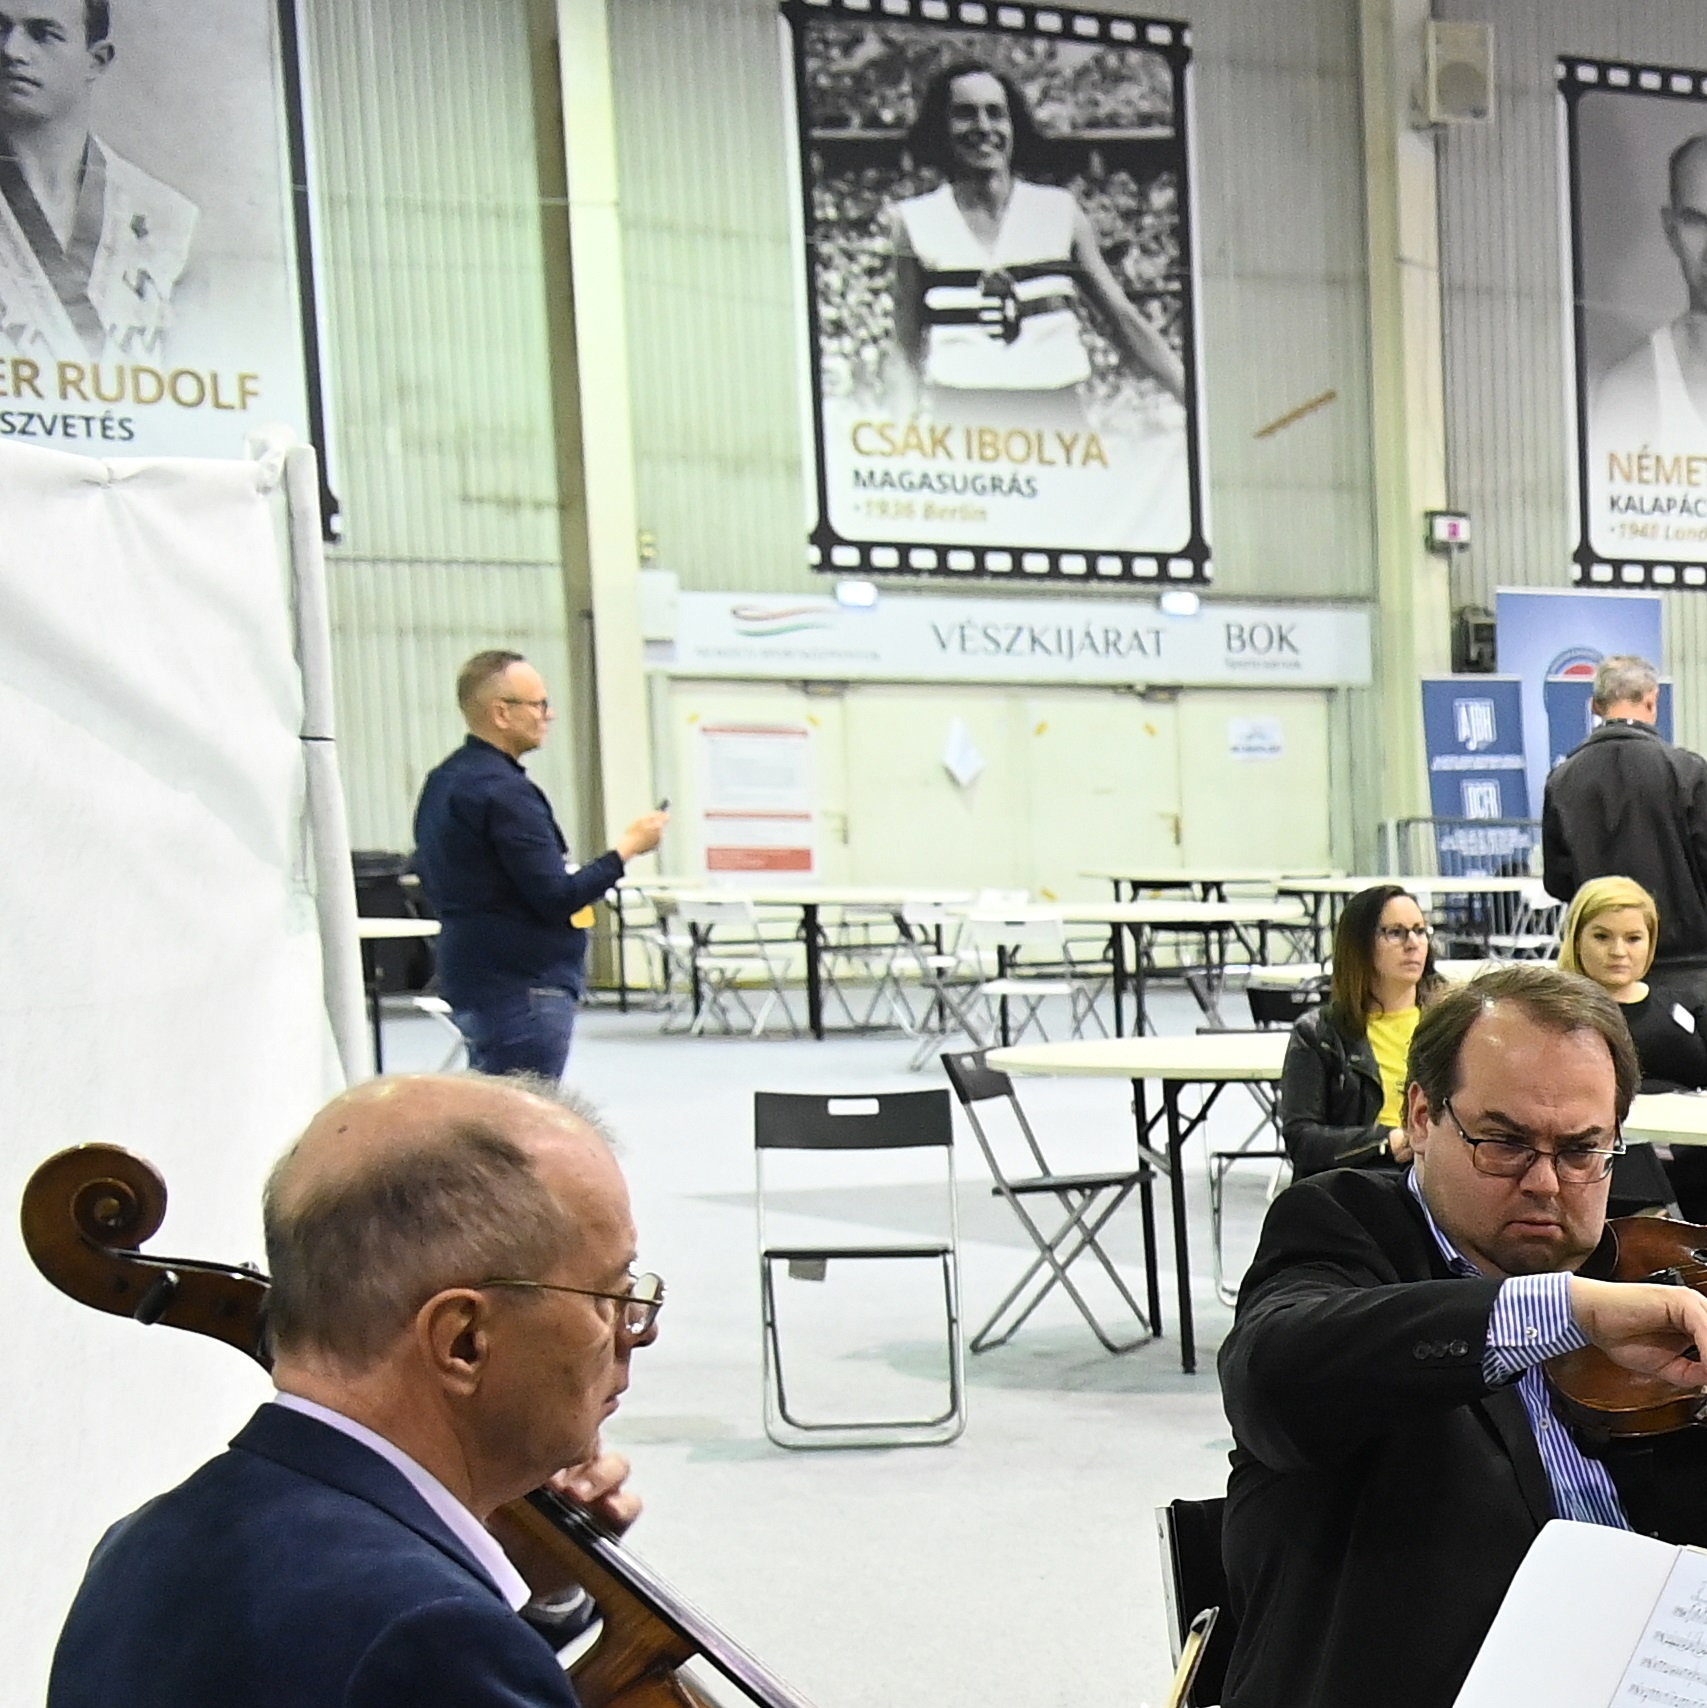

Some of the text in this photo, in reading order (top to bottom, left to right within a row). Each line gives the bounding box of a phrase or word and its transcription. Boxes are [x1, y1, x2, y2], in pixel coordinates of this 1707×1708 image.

[57, 360, 260, 411] RUDOLF
[851, 414, 1110, 469] CSÁK IBOLYA
[852, 469, 1039, 499] MAGASUGRÁS
[931, 618, 1166, 662] VÉSZKIJÁRAT
[1225, 621, 1300, 655] BOK
